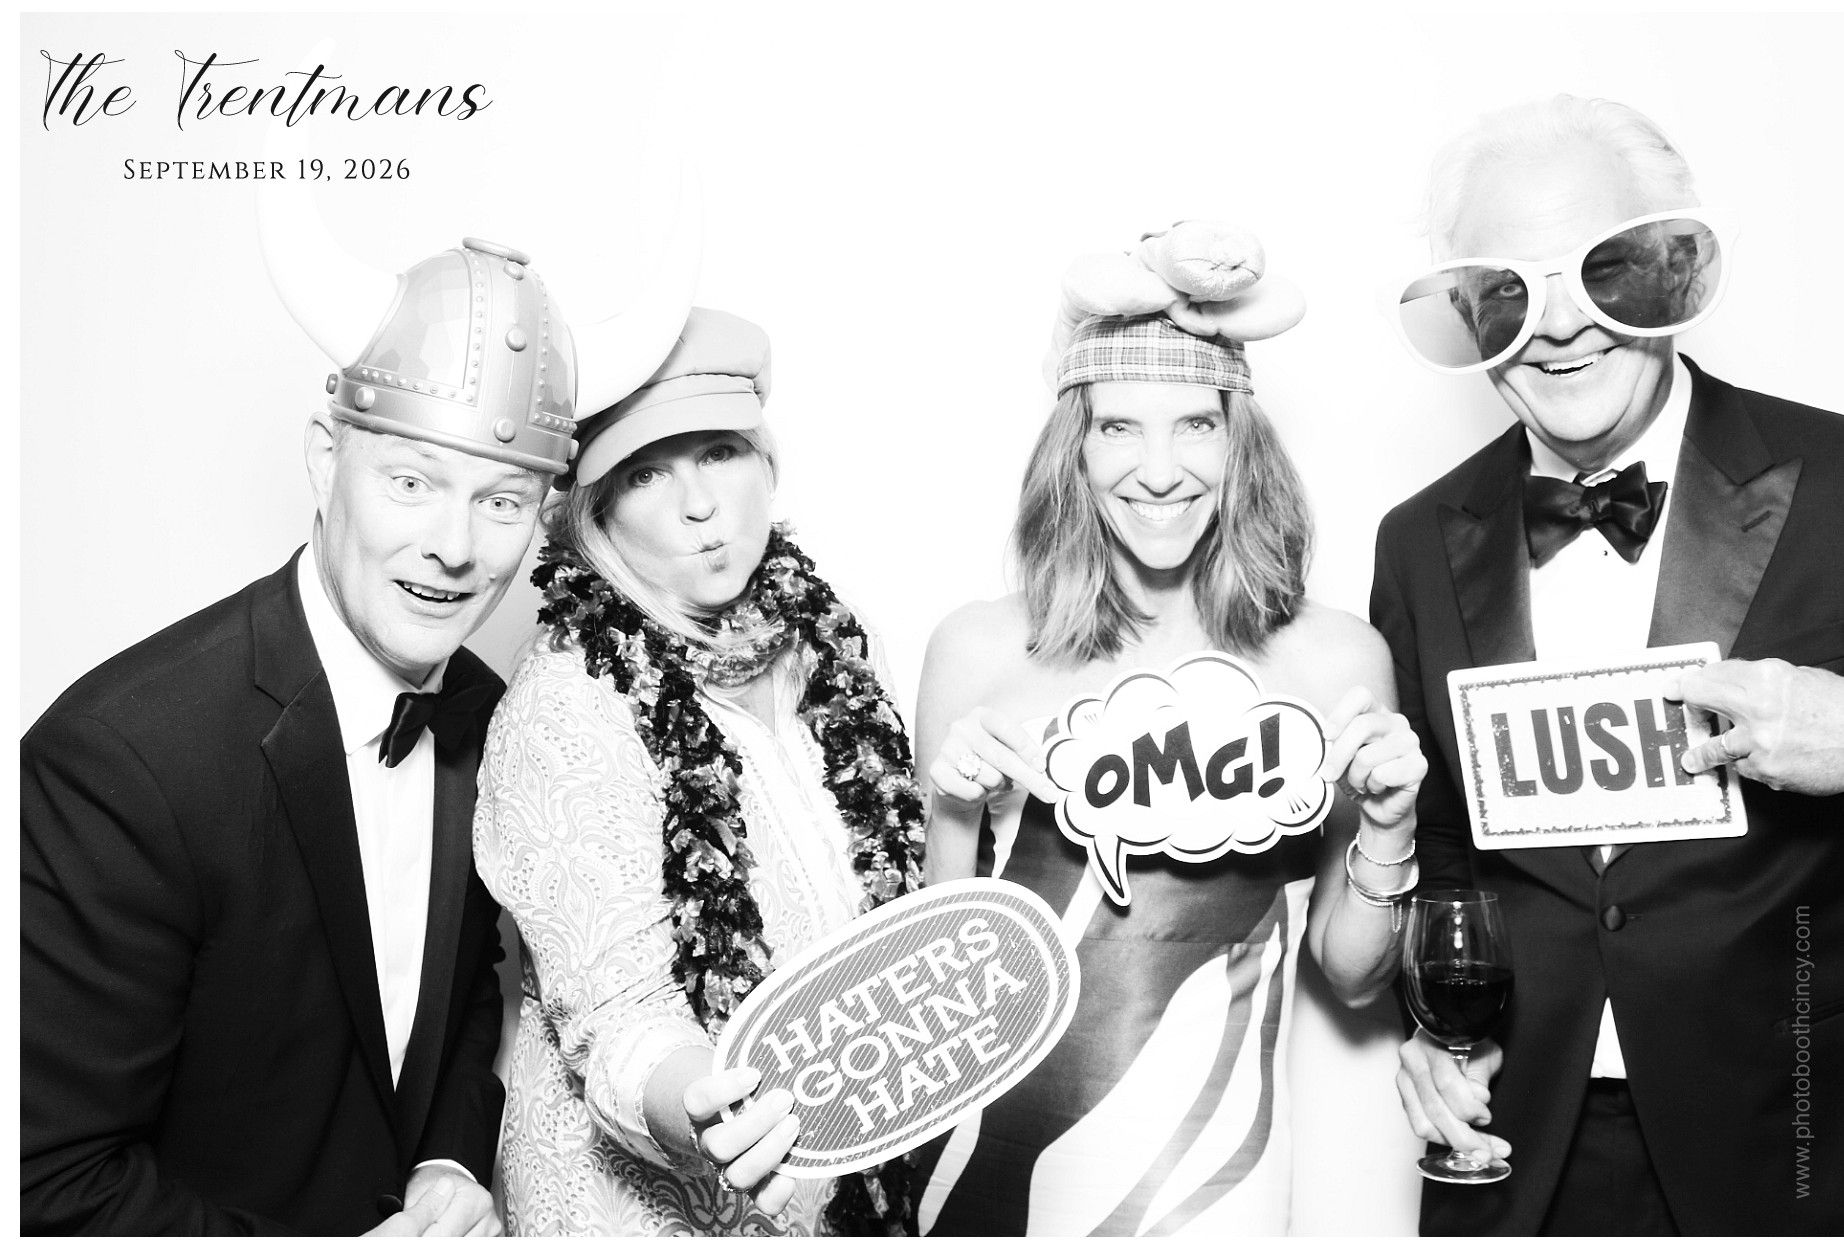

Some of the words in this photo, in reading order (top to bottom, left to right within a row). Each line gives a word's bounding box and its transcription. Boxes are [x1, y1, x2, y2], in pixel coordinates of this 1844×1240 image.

[1084, 712, 1285, 809] OMG!
[1490, 697, 1696, 798] LUSH
[762, 918, 1000, 1073] HATERS
[793, 958, 1027, 1107] GONNA
[844, 1014, 1011, 1134] HATE
